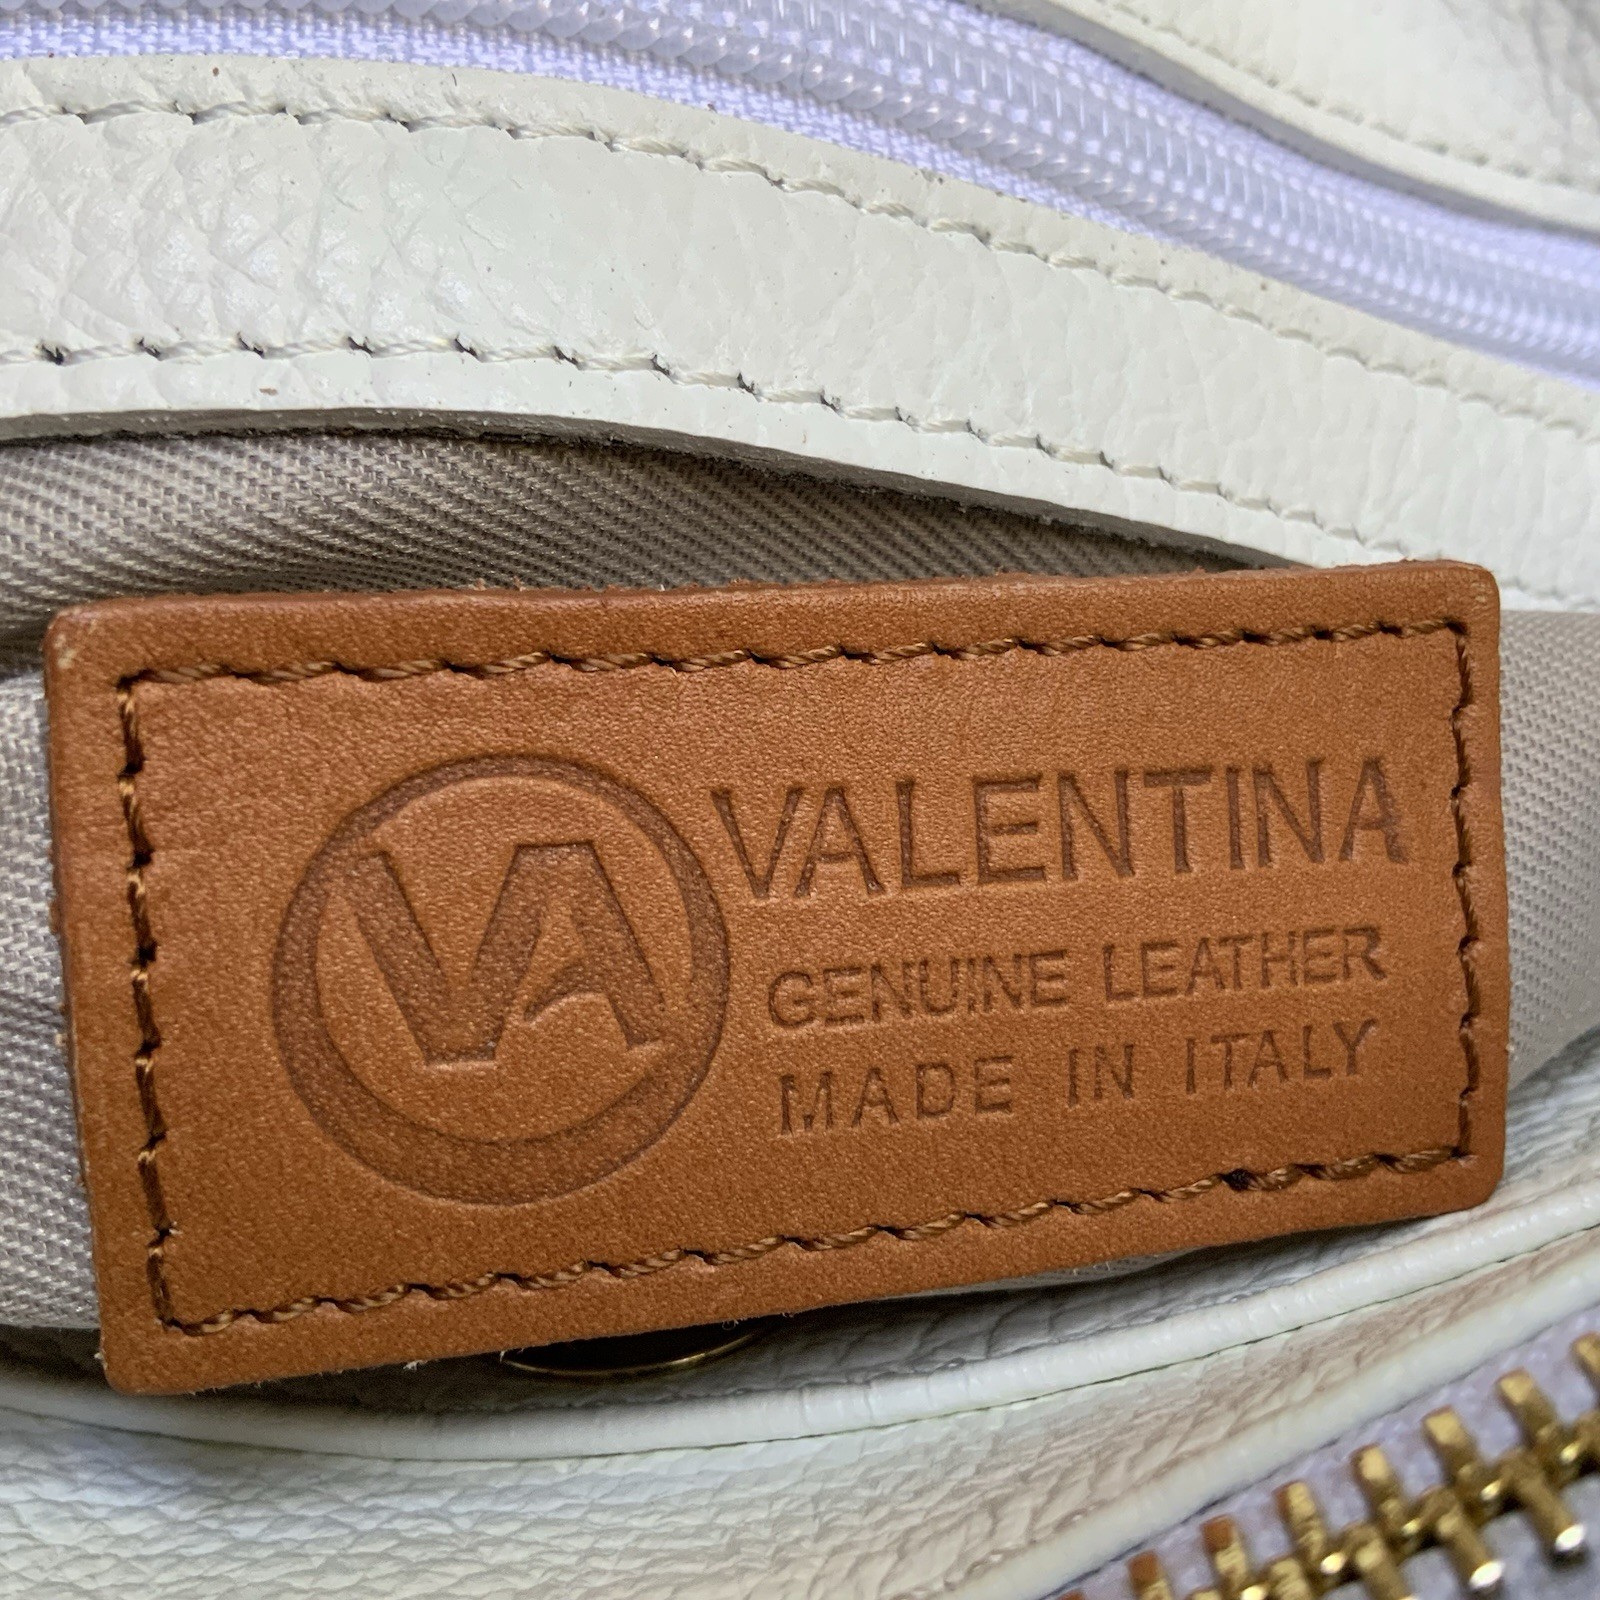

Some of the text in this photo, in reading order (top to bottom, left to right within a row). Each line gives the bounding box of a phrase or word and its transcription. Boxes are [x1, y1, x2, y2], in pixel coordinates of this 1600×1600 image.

[709, 759, 1408, 899] VALENTINA
[346, 844, 667, 1062] VA
[768, 926, 1387, 1029] GENUINE LEATHER
[781, 1017, 1377, 1137] MADE IN ITALY
